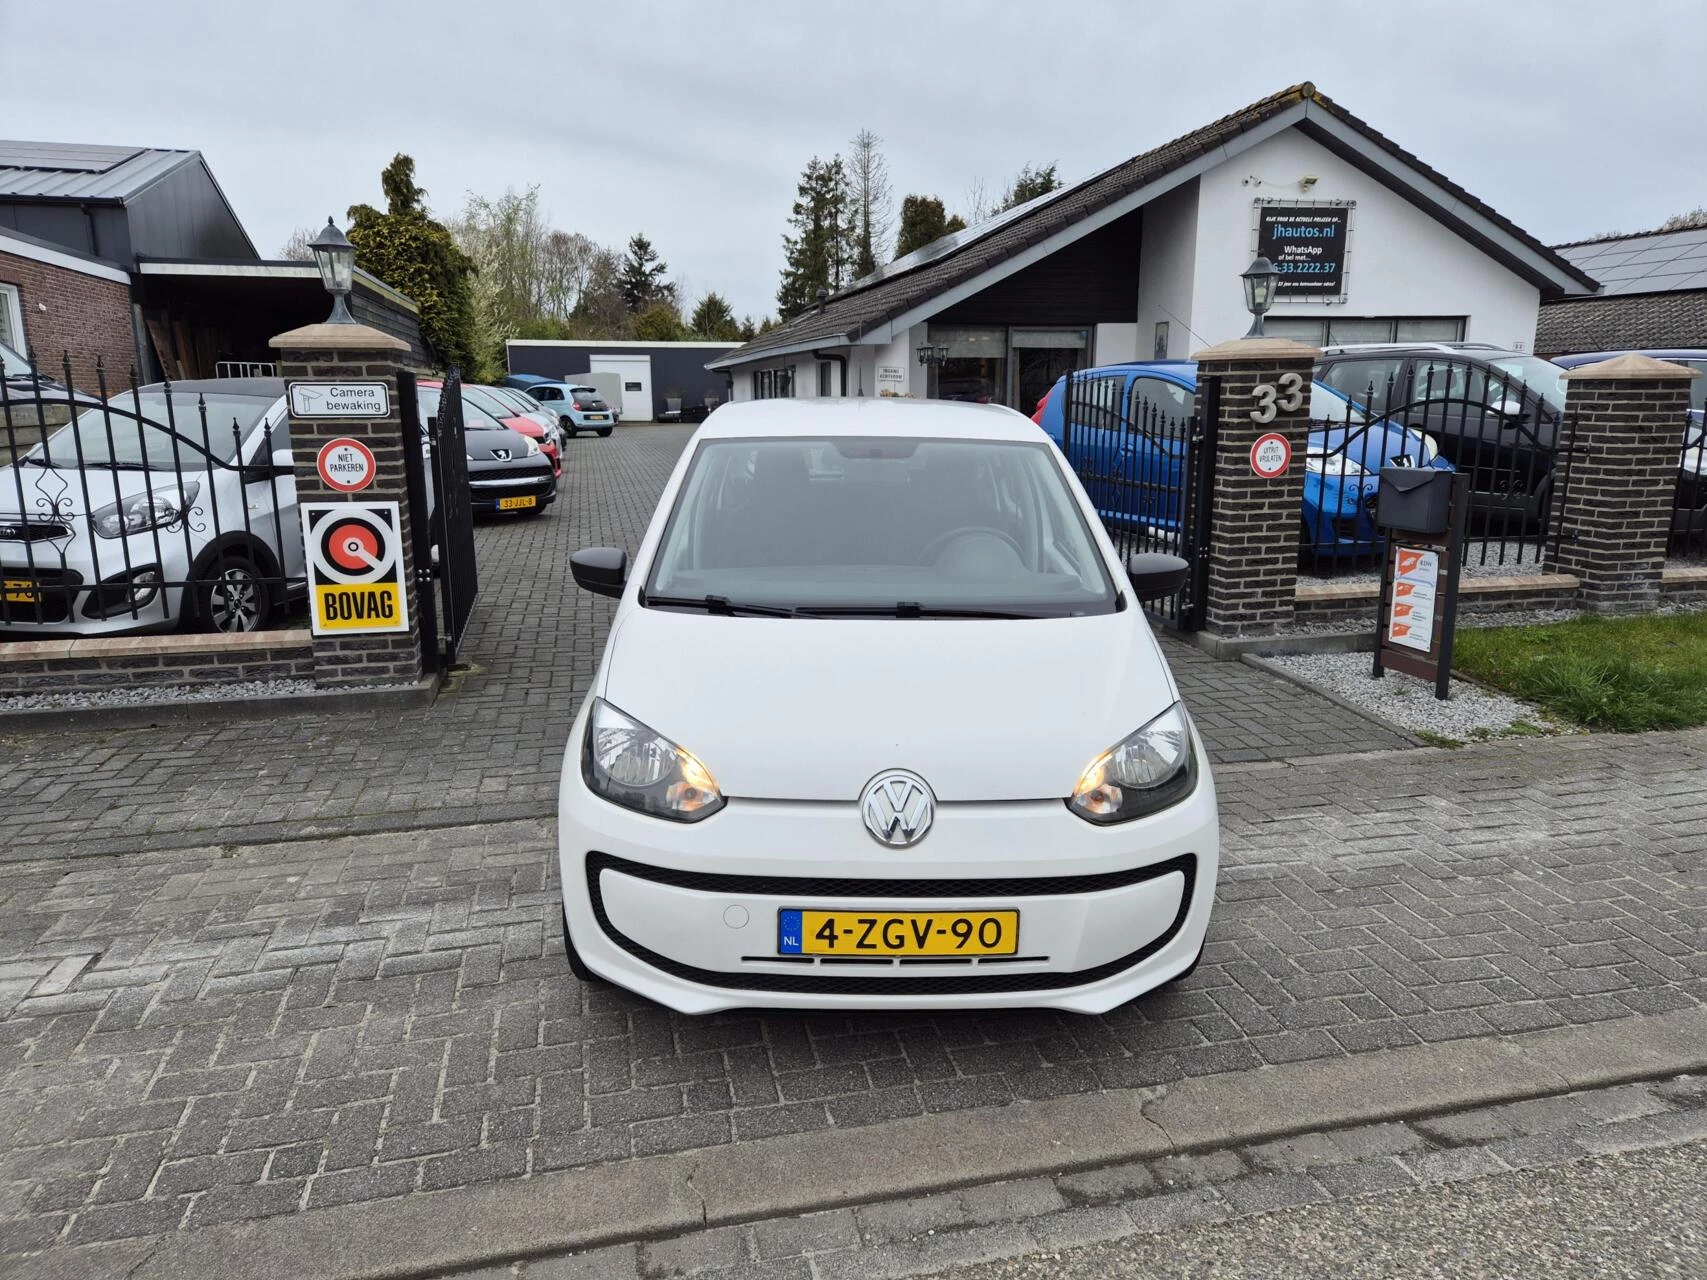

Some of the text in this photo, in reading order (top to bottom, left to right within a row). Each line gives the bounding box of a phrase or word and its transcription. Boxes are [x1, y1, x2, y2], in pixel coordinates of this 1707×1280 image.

[1272, 223, 1336, 240] jhautos.nl
[1284, 245, 1323, 255] WhatsApp
[1272, 262, 1336, 273] 6-33.2222.37
[329, 387, 375, 398] Camera
[1250, 372, 1303, 424] 33
[326, 401, 381, 413] bewaking
[338, 453, 353, 463] NIET
[329, 463, 364, 473] PARKEREN
[323, 590, 394, 621] BOVAG
[783, 916, 1002, 949] NL 4-ZGV-90
